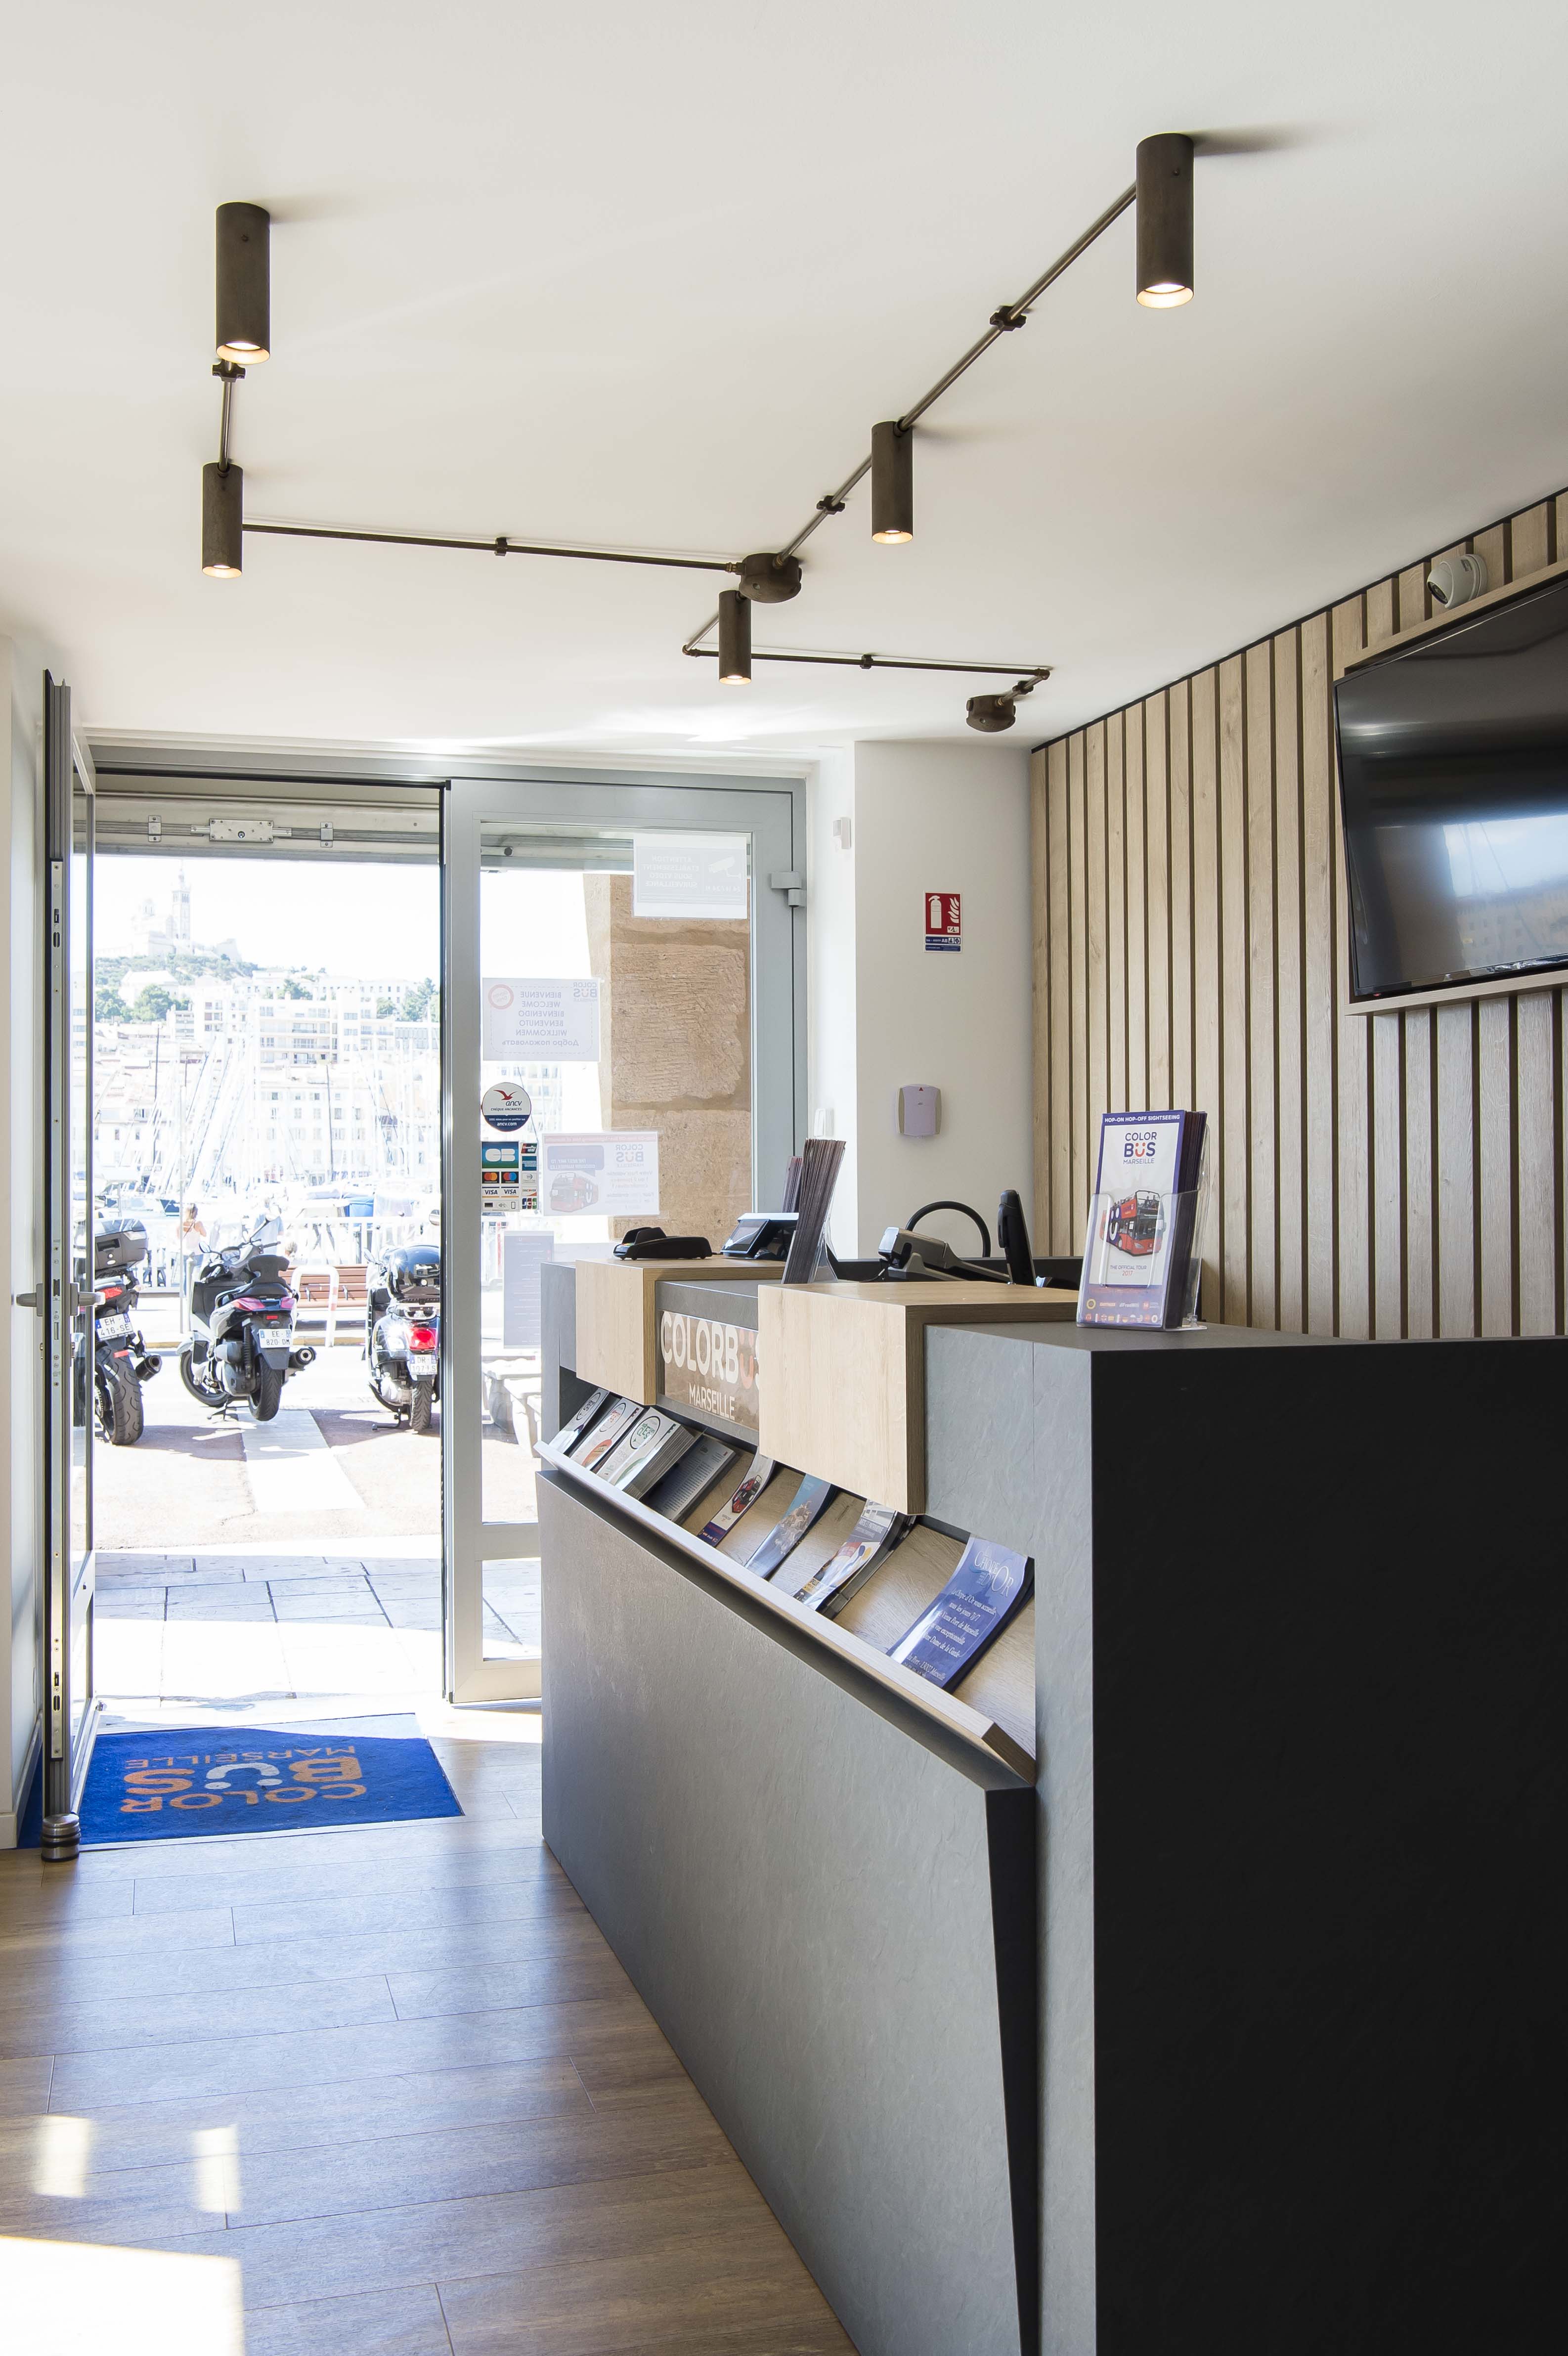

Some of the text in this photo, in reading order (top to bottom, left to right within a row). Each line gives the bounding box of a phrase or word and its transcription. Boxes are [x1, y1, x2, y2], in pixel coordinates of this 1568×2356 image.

[1125, 1132, 1157, 1141] COLOR
[485, 1148, 515, 1162] CB
[104, 1317, 115, 1326] EH
[101, 1323, 130, 1336] 416-SE
[689, 1383, 736, 1421] MARSEILLE
[126, 1745, 355, 1769] MARSEILLE
[120, 1783, 367, 1812] COLOR
